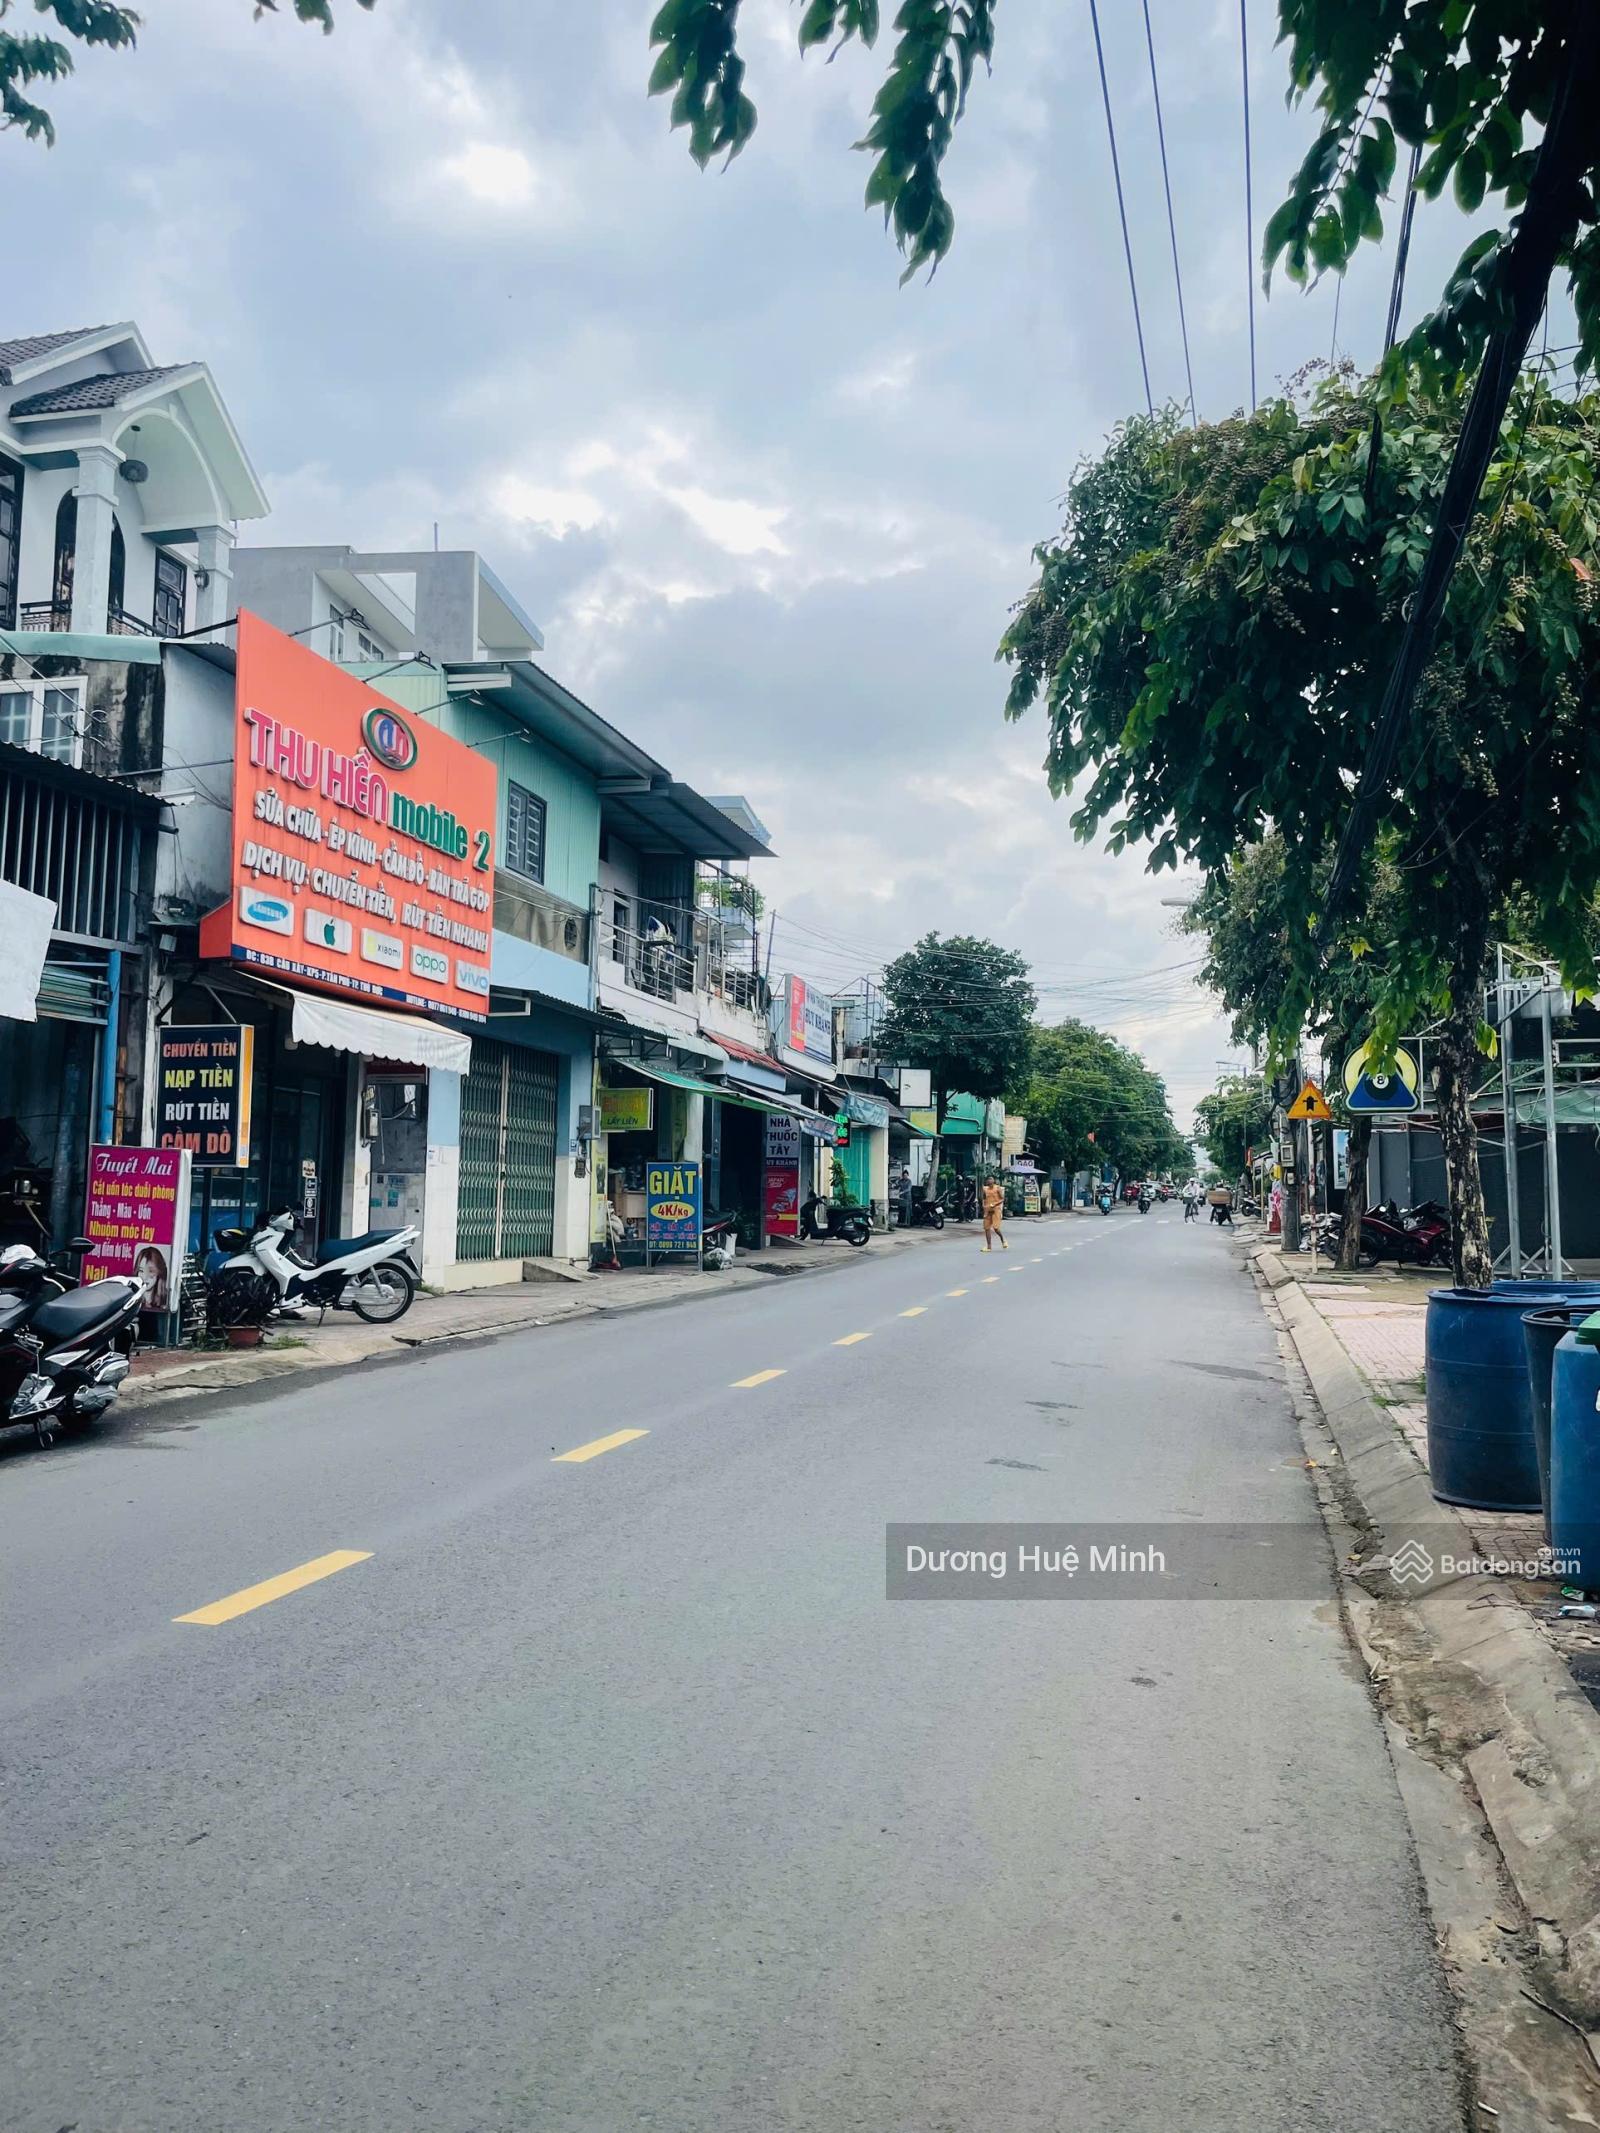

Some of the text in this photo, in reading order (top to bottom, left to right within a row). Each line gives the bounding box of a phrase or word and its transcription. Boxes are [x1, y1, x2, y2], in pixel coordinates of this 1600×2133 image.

[244, 707, 320, 788] THU
[387, 790, 469, 861] mobile
[473, 830, 491, 871] 2
[254, 787, 284, 827] SỬA
[285, 805, 322, 844] CHỮA
[345, 828, 377, 866] KÍNH
[469, 883, 490, 912] GÓP
[242, 840, 283, 879] DỊCH
[311, 867, 366, 907] CHUYỂN
[401, 899, 426, 931] RÚT
[451, 920, 489, 954] NHANH
[459, 971, 488, 989] vivo
[211, 1037, 237, 1056] TIỀN
[165, 1063, 233, 1091] NẠP TIỀN
[165, 1097, 229, 1120] RÚT TIỀN
[770, 1115, 791, 1128] NHÀ
[161, 1126, 231, 1154] CẦM ĐỒ
[769, 1144, 790, 1155] TÂY
[96, 1153, 173, 1176] Tuyết Mai
[649, 1166, 697, 1200] GIẶT
[86, 1265, 108, 1281] Nail
